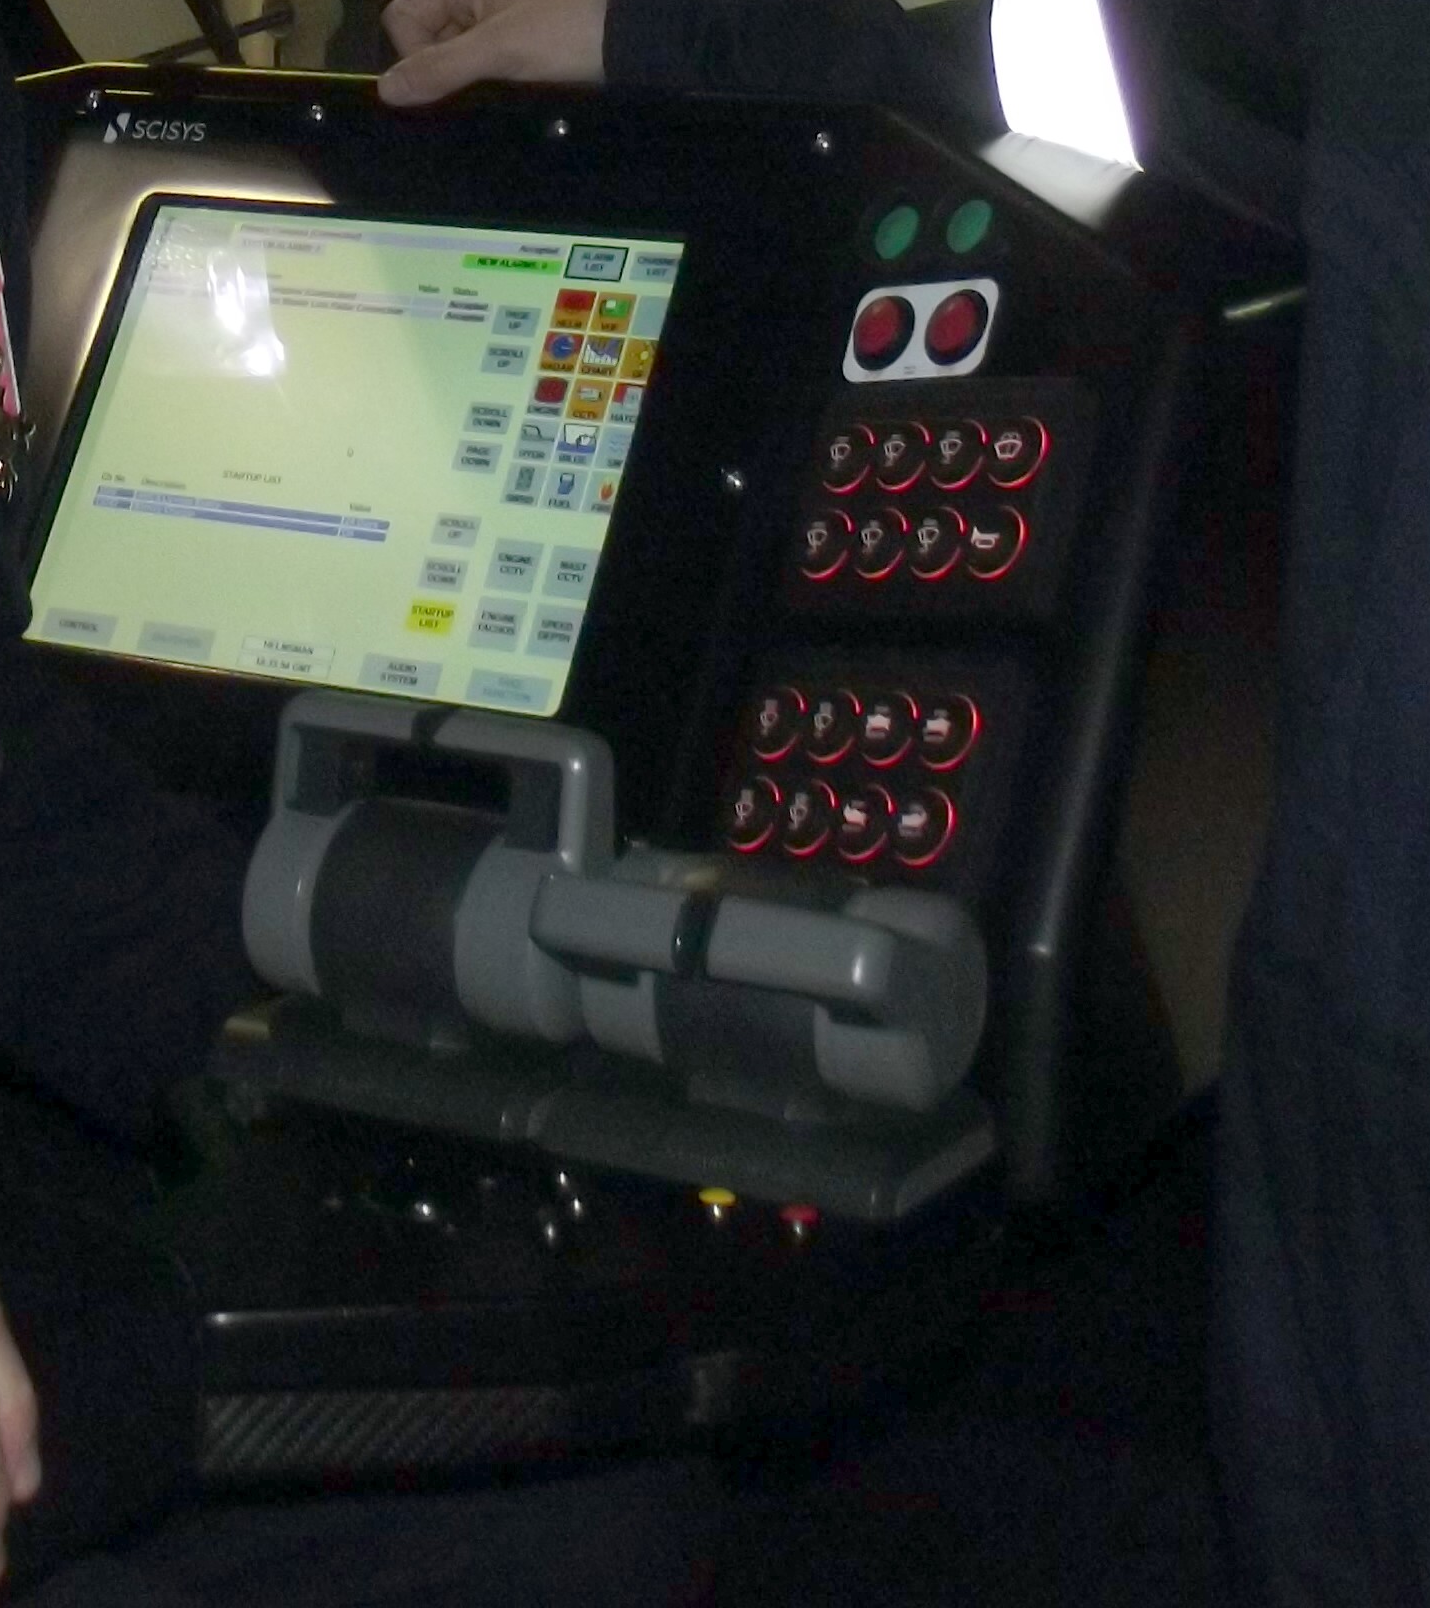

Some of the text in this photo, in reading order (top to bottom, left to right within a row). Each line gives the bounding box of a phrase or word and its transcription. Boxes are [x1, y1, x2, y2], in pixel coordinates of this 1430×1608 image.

[132, 119, 207, 142] SCISYS
[477, 257, 498, 267] NEW
[581, 252, 616, 263] ALARM
[585, 262, 604, 273] LIST
[645, 267, 668, 277] LIST
[488, 347, 524, 359] SCROLL
[581, 365, 612, 376] CHART
[472, 405, 508, 418] SCROLL
[472, 417, 501, 428] DOWN
[465, 445, 490, 456] PAGE
[460, 455, 491, 468] DOWN
[547, 497, 571, 509] FUEL
[497, 551, 532, 565] ENGINE
[426, 561, 461, 574] SCROLL
[499, 565, 525, 576] CCTV
[556, 571, 584, 583] CCTV
[412, 604, 455, 619] STARTUP
[481, 609, 516, 623] ENGINE
[418, 618, 440, 629] LIST
[263, 638, 315, 655] HELMSMAN
[387, 661, 418, 673] AUDIO
[380, 672, 418, 686] SYSTEM
